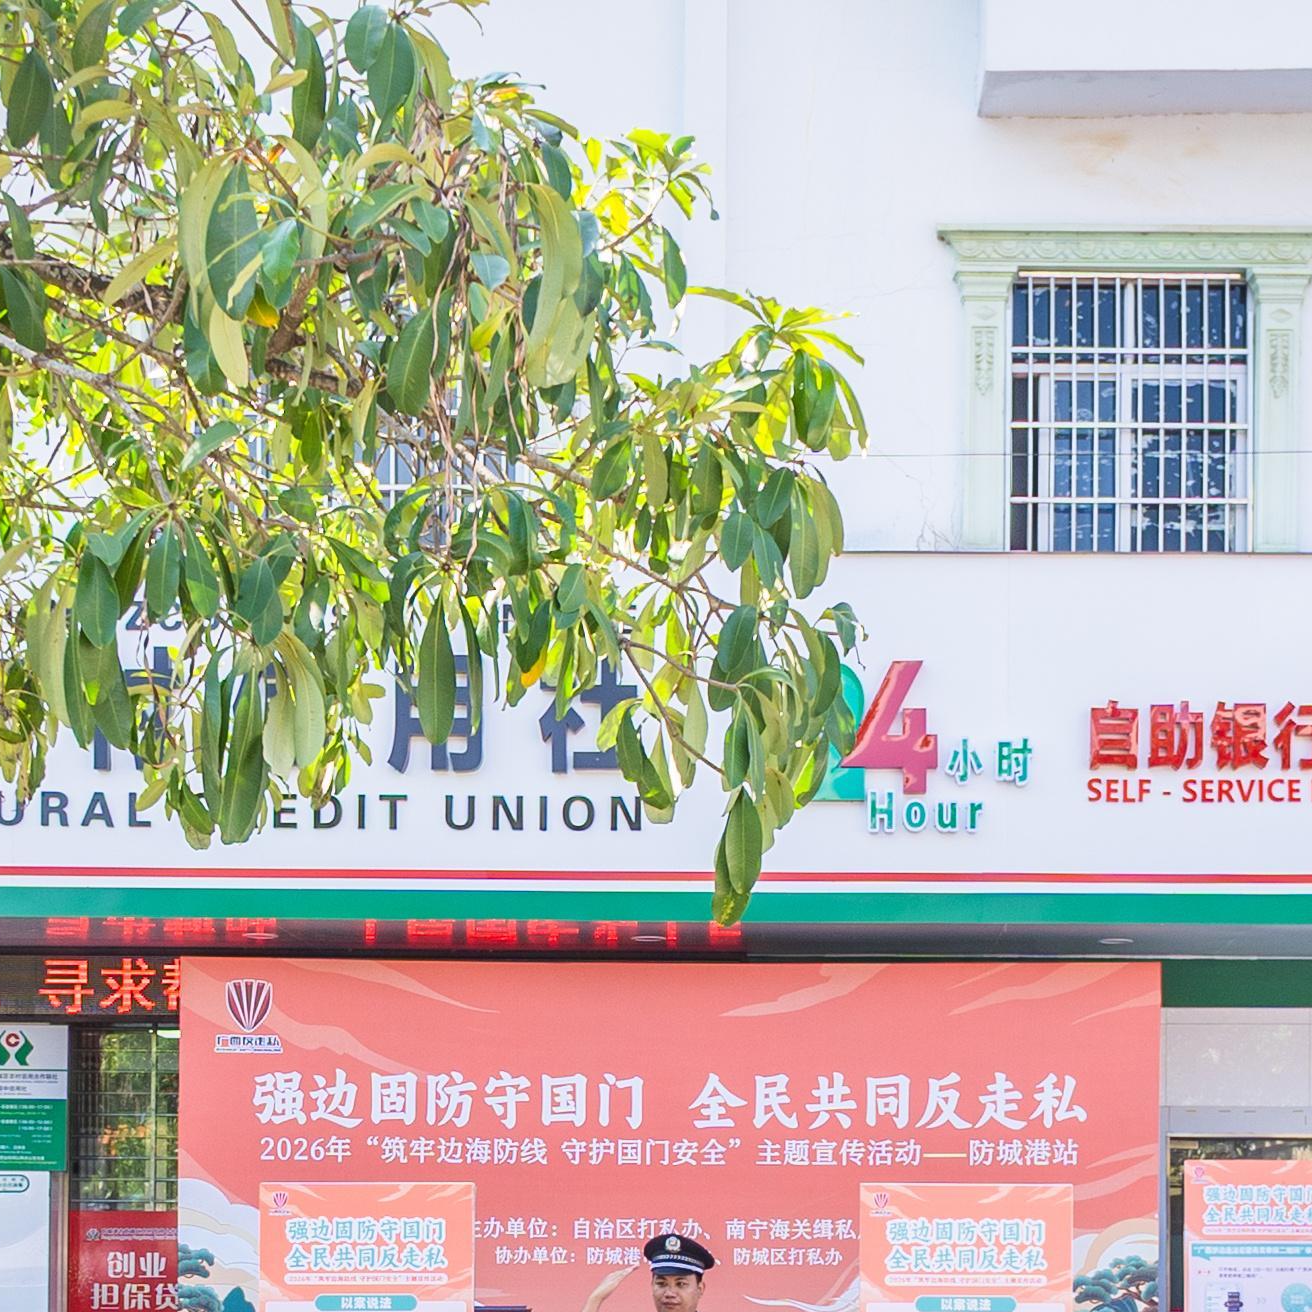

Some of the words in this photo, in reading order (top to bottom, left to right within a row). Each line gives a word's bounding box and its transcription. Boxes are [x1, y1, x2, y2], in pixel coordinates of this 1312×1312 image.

[947, 738, 1033, 784] 小时
[1087, 779, 1151, 803] SELF
[1182, 779, 1303, 803] SERVICE
[228, 794, 407, 831] EDIT
[445, 795, 643, 831] UNION
[869, 791, 983, 831] Hour
[252, 1070, 645, 1129] 强边固防守国门
[689, 1071, 1088, 1130] 全民共同反走私
[260, 1136, 548, 1165] 2026年“筑牢边海防线
[287, 1218, 445, 1242] 强边固防守国门
[474, 1217, 861, 1242] 办单位：自治区打私办、南宁海关缉私
[888, 1220, 1044, 1243] 强边固防守国门
[107, 1251, 167, 1278] 创业
[287, 1245, 447, 1269] 全民共同反走私
[494, 1246, 843, 1267] 协办单位：防城港、防城区打私办
[888, 1248, 1046, 1271] 全民共同反走私
[340, 1297, 392, 1310] 以案说法
